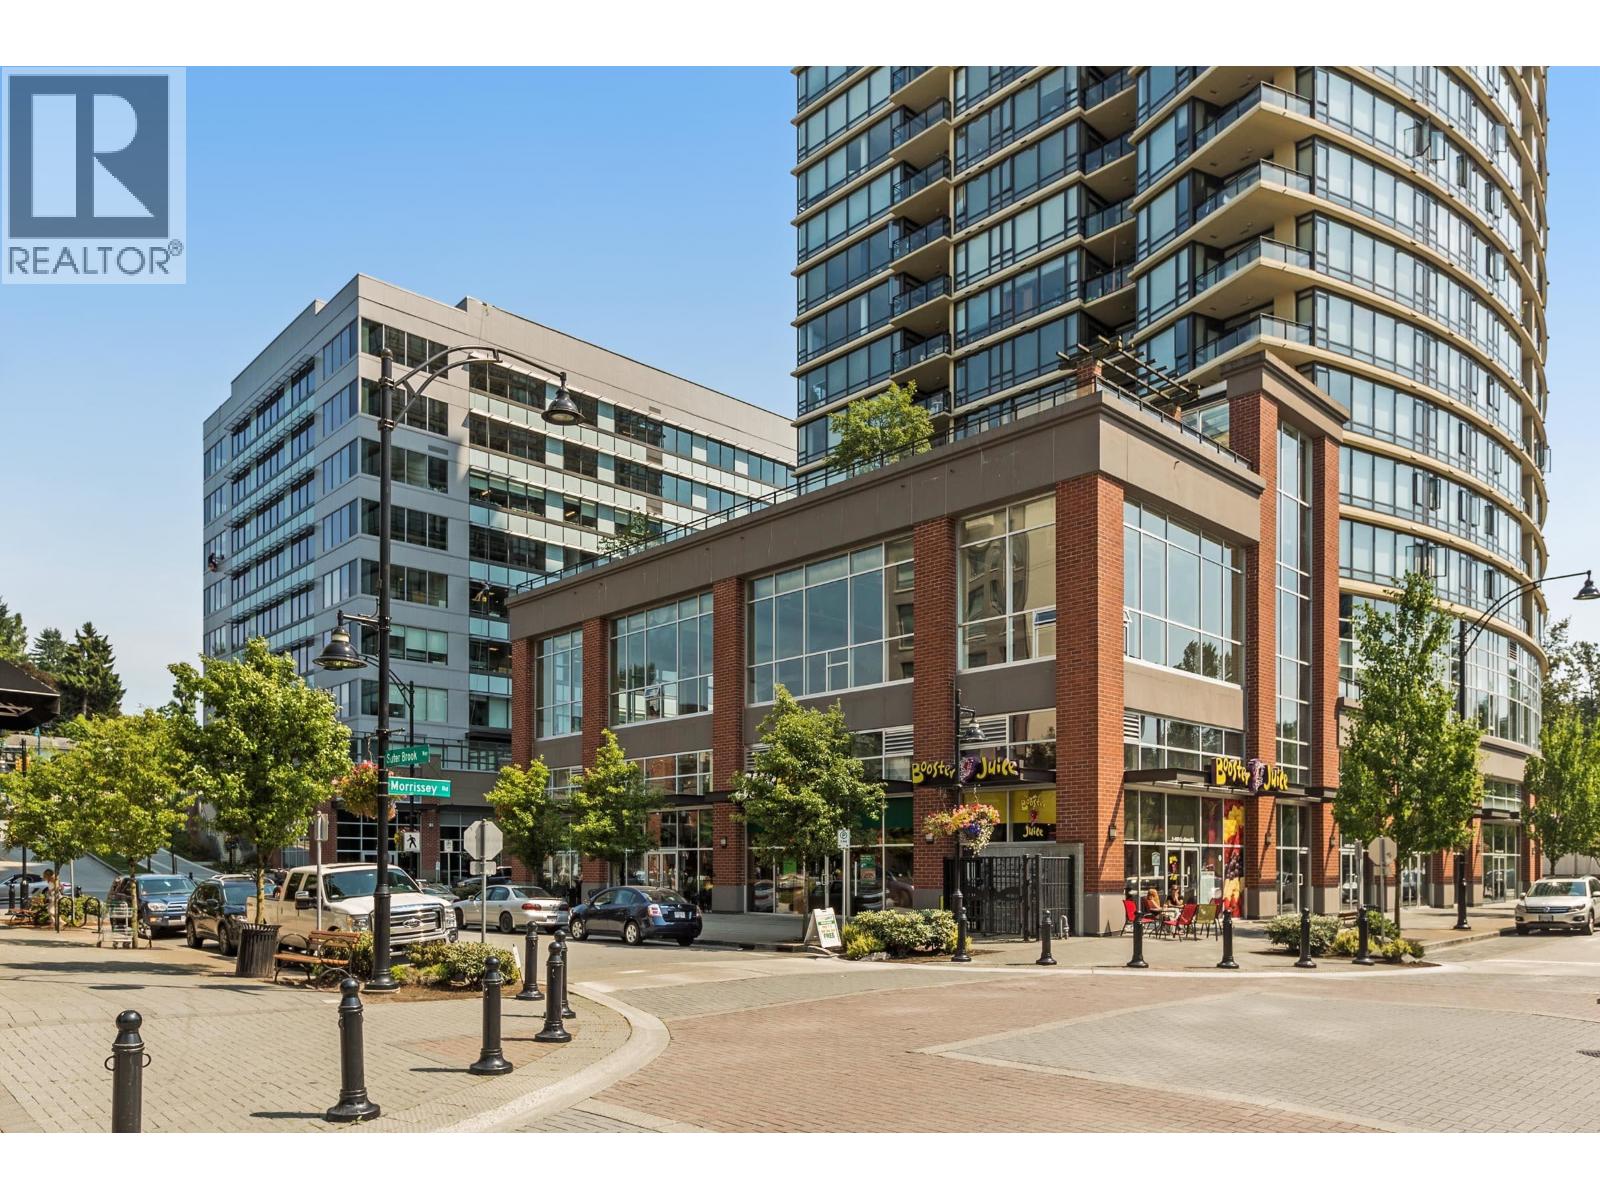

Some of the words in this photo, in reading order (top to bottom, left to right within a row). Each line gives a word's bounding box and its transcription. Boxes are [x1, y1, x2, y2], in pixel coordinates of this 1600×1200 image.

[386, 753, 401, 764] Suter
[401, 750, 418, 762] Brook
[912, 760, 956, 784] Booster
[976, 756, 1019, 780] Juice
[1215, 756, 1250, 786] Booster
[1263, 764, 1289, 791] Juice
[390, 780, 438, 796] Morrissey
[1020, 797, 1047, 811] Booster
[1022, 825, 1044, 838] Juice
